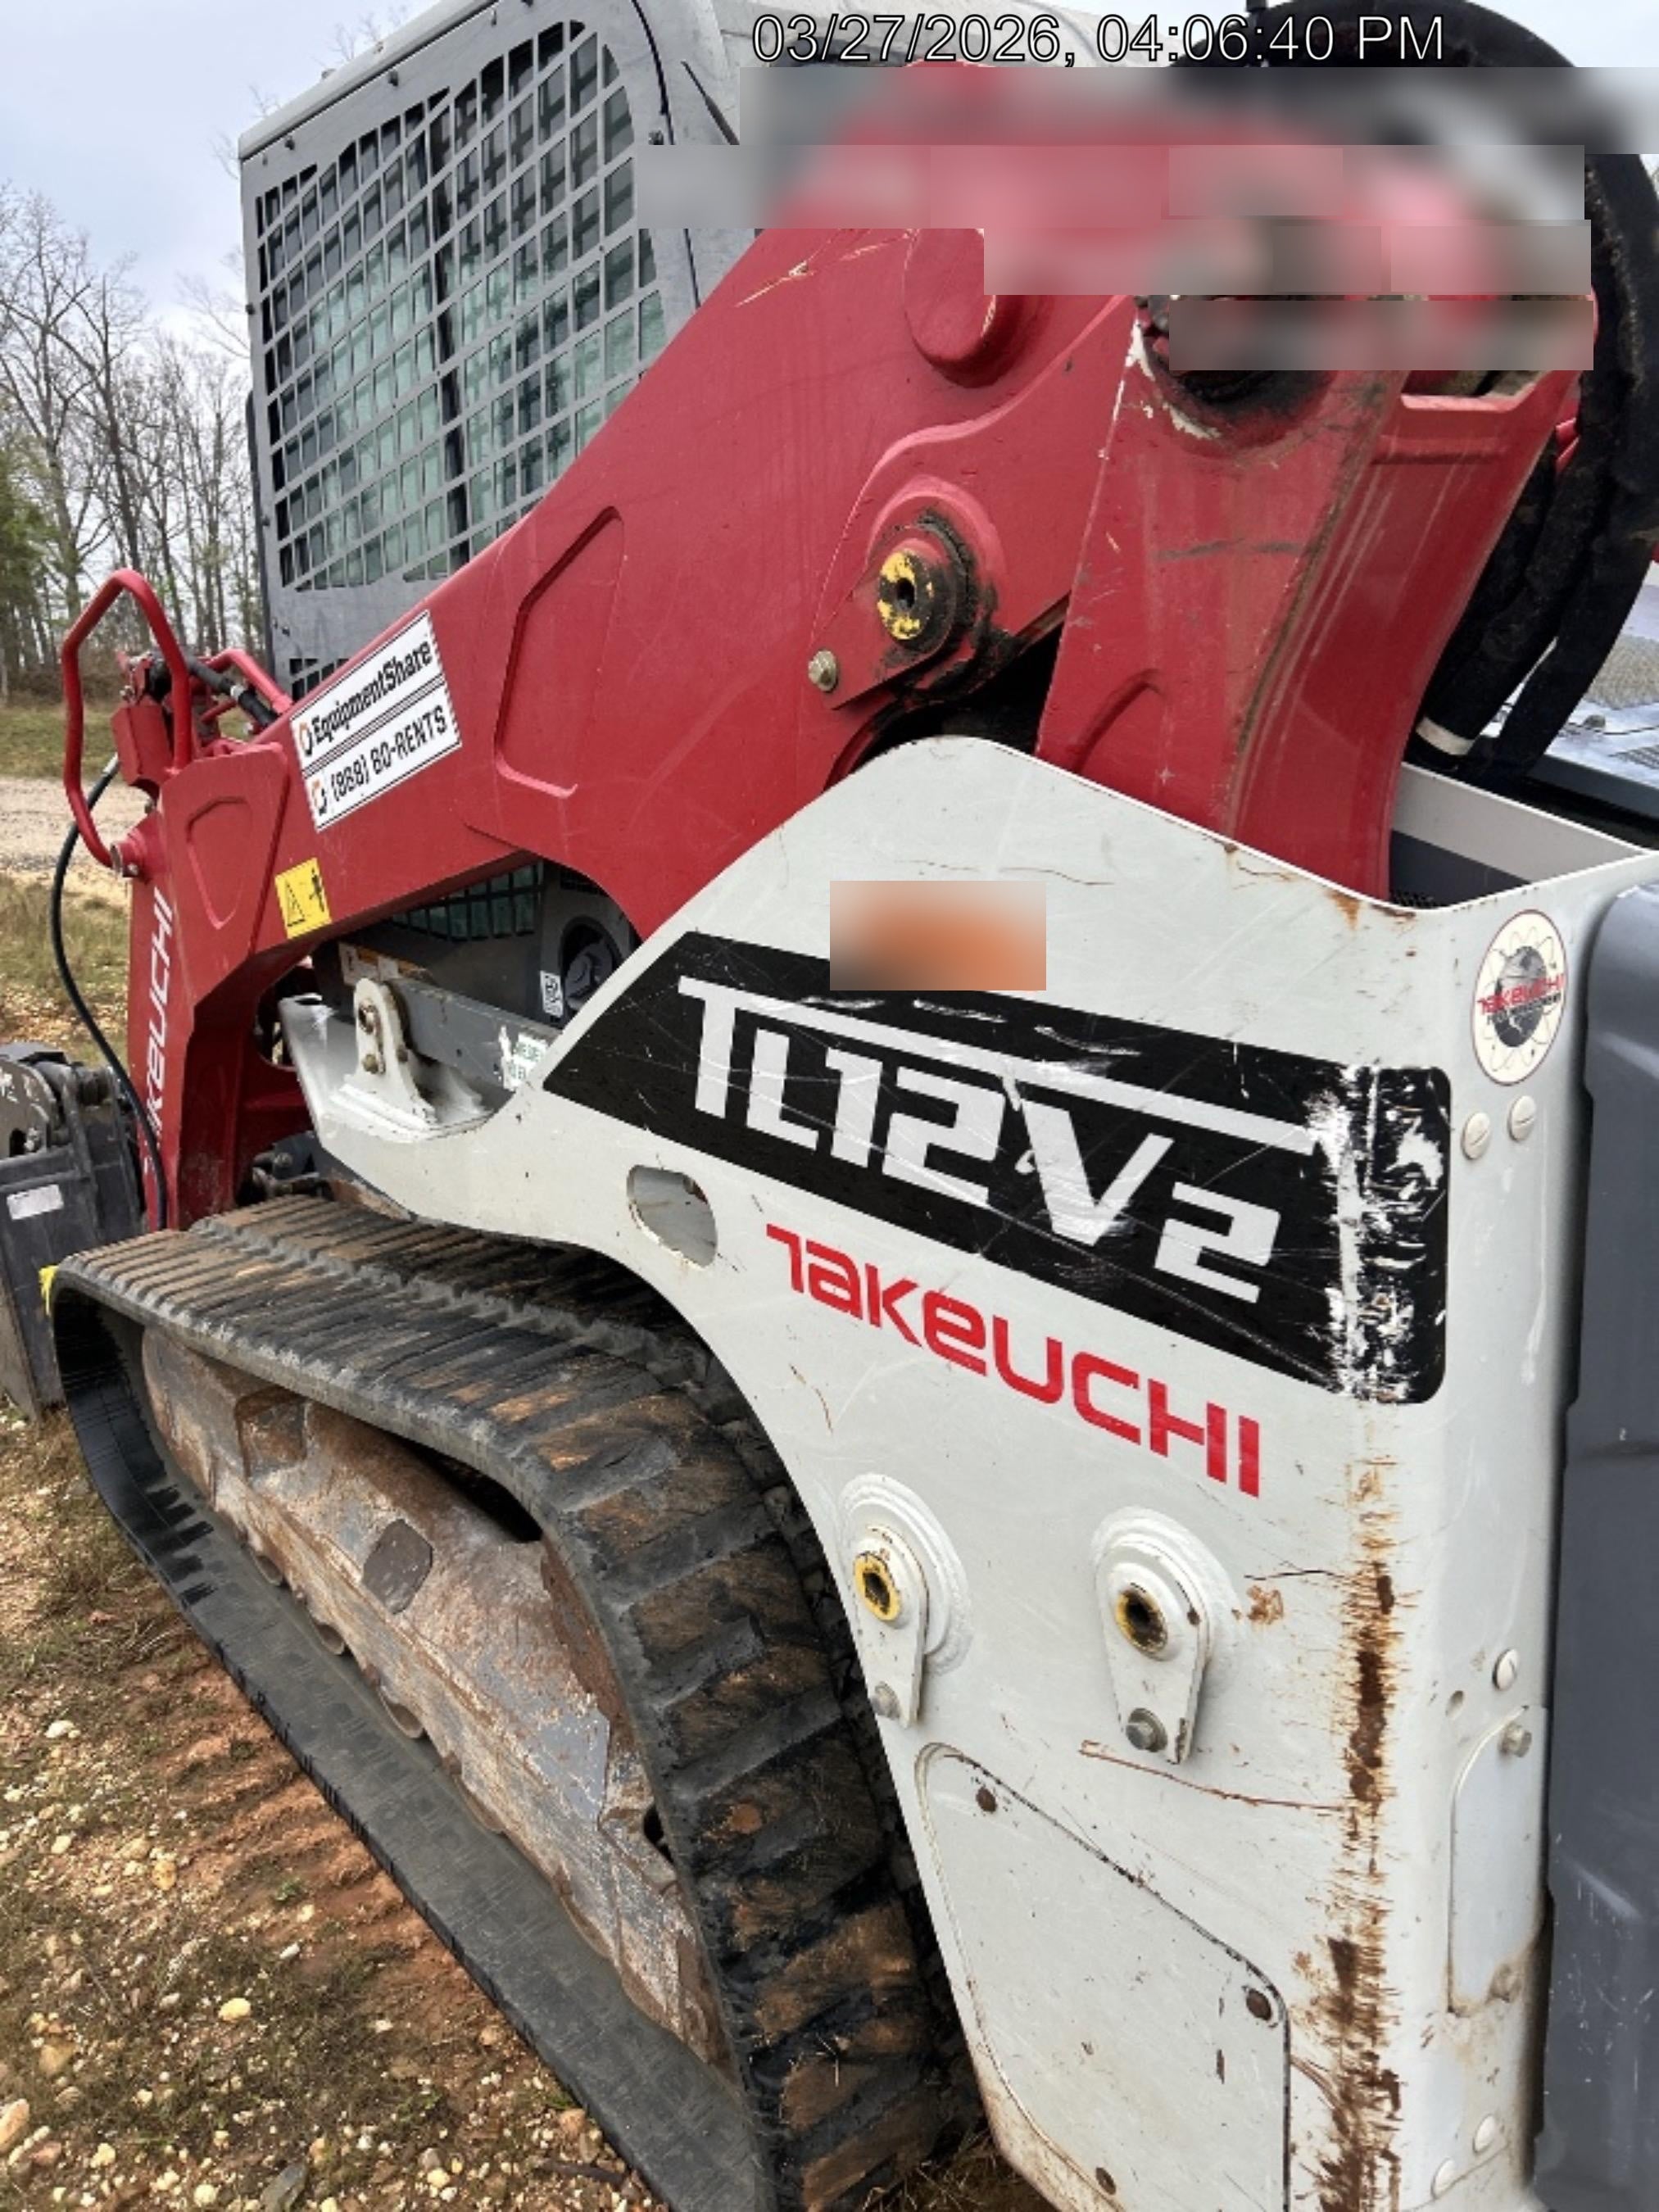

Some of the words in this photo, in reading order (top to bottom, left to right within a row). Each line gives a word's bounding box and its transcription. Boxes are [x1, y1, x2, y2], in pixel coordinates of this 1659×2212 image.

[310, 641, 433, 745] EquipmentShare
[678, 975, 1315, 1304] TL12V2
[765, 1223, 1260, 1499] TAKEUCHI
